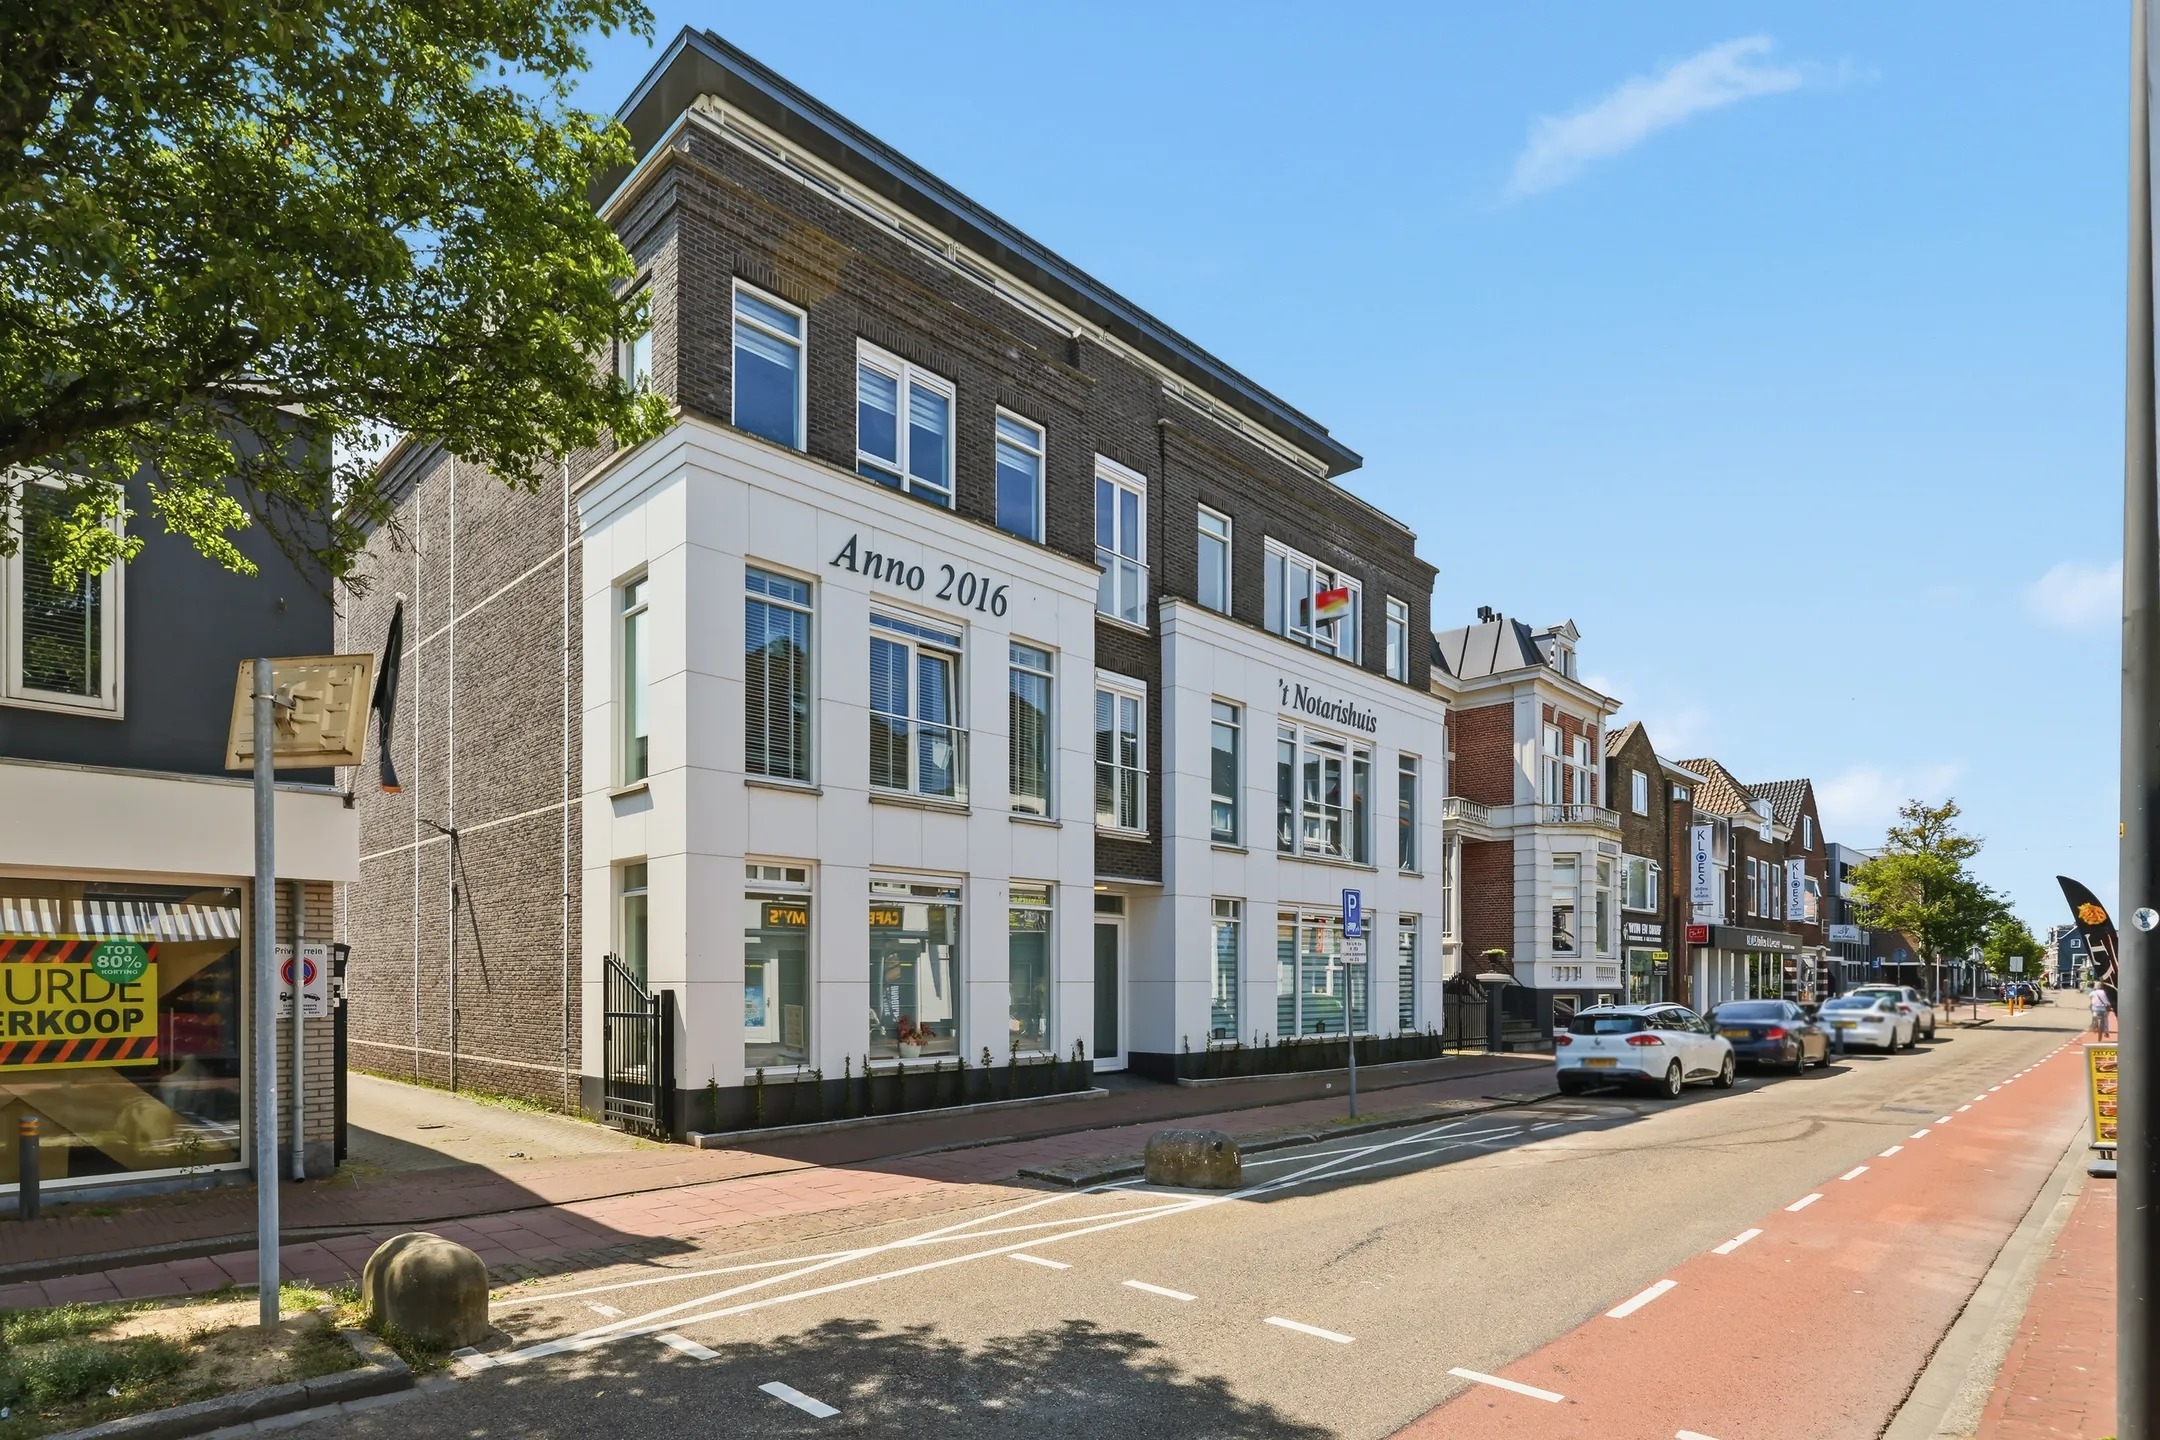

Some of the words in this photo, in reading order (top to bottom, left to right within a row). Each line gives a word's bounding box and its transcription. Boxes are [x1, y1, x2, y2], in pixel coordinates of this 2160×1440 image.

[829, 534, 925, 591] Anno
[936, 564, 1010, 617] 2016
[1293, 684, 1377, 733] Notarishuis
[1696, 830, 1707, 885] KLOES
[96, 955, 142, 969] 80%
[103, 945, 136, 955] TOT
[5, 968, 144, 1005] URDE
[0, 1008, 144, 1037] RKOOP
